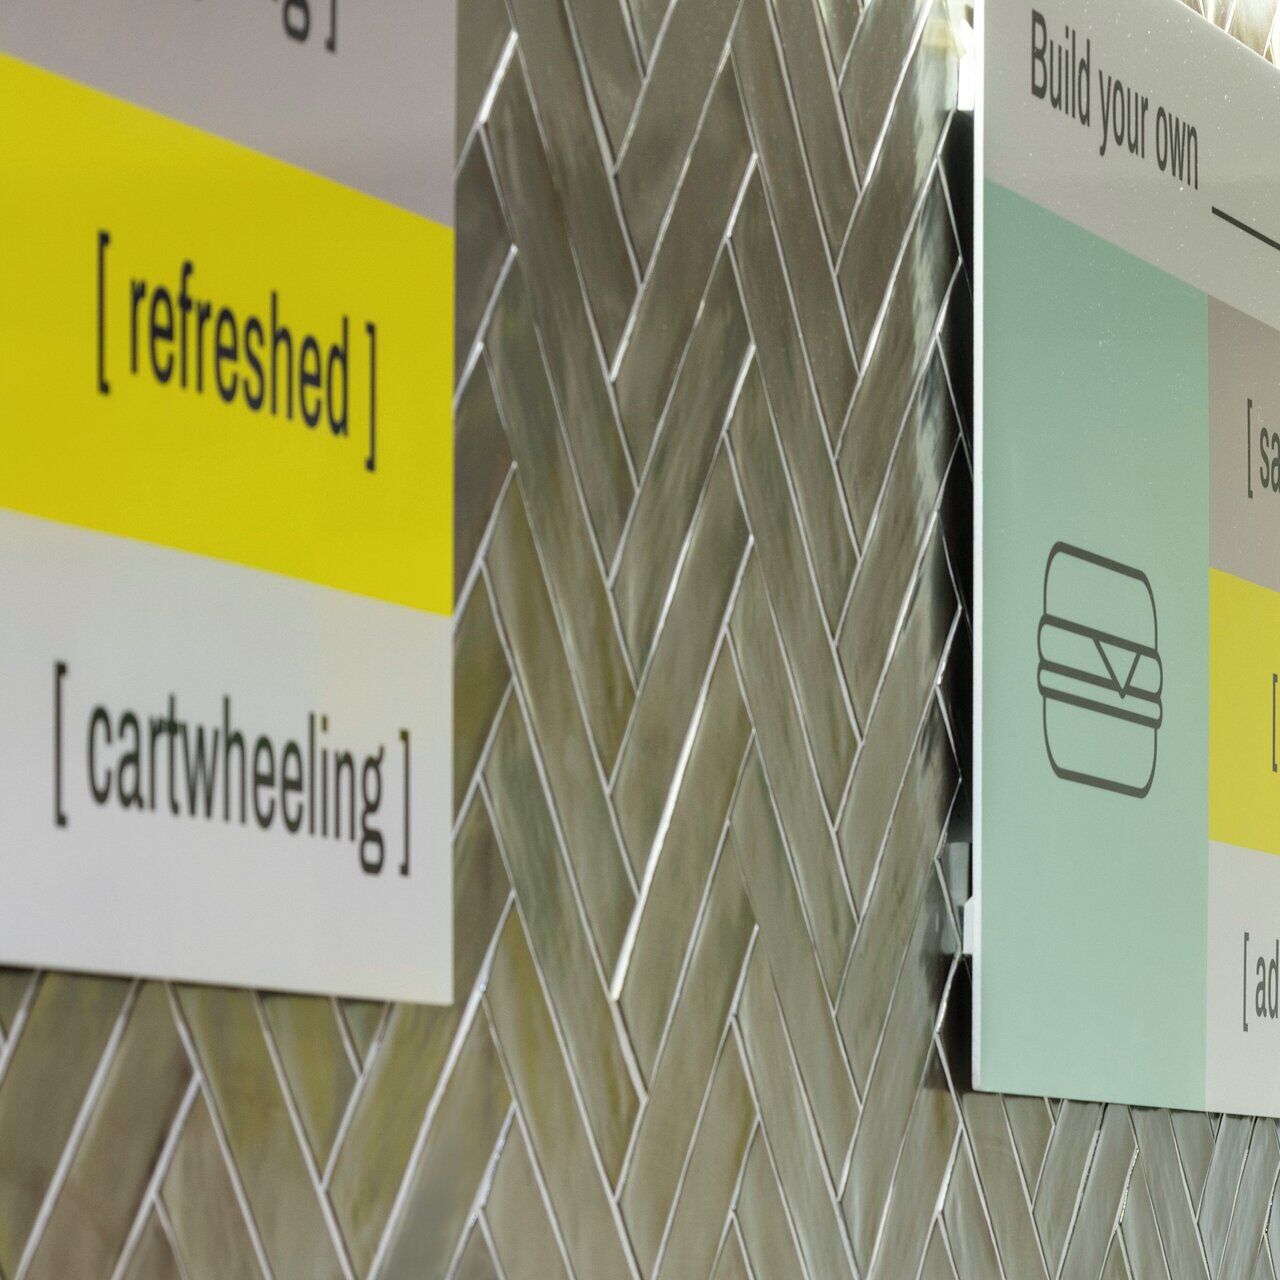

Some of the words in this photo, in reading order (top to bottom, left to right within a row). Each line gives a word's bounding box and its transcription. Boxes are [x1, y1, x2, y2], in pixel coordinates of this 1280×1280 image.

[1031, 9, 1091, 128] Build
[1098, 69, 1149, 158] your
[1155, 106, 1199, 190] own
